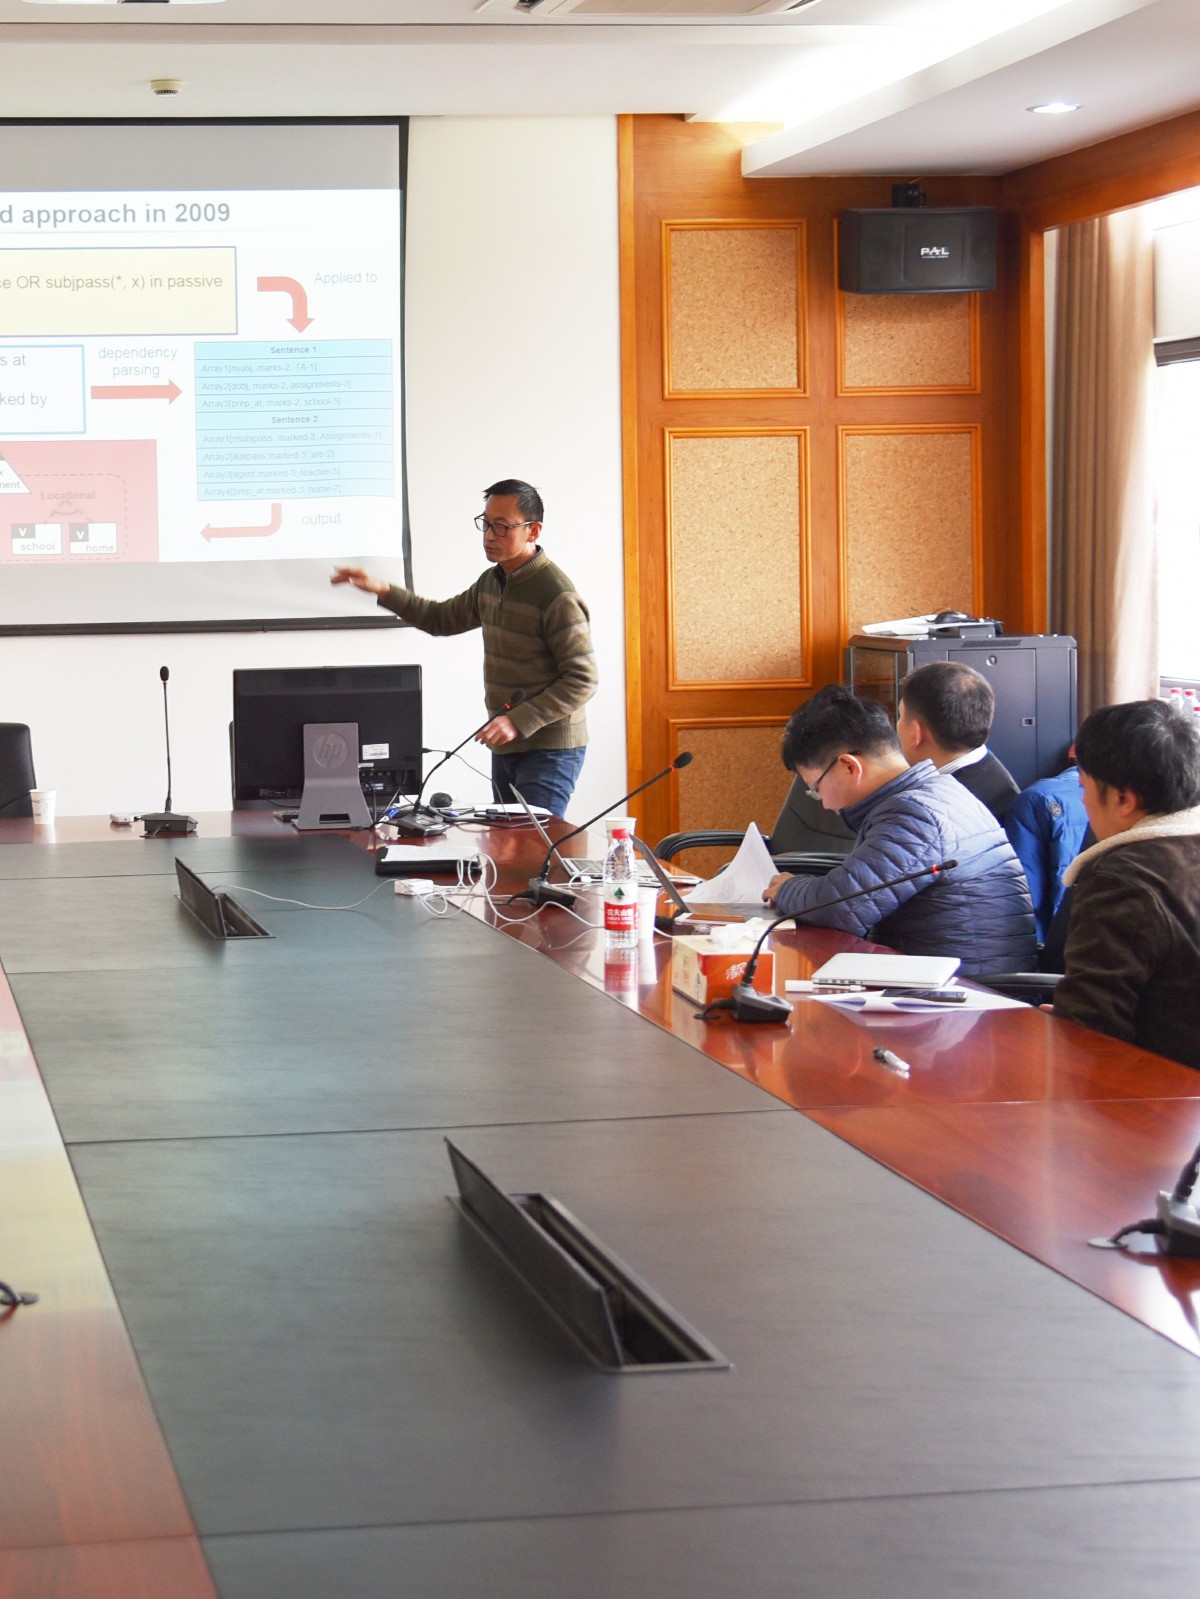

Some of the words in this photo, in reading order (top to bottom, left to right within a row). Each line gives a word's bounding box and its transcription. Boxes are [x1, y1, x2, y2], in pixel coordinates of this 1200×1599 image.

[22, 203, 136, 228] approach
[146, 203, 166, 223] in
[175, 202, 230, 223] 2009
[920, 246, 950, 256] PAL
[16, 275, 41, 289] OR
[150, 274, 162, 288] in
[167, 274, 223, 290] passive
[314, 271, 362, 287] Applied
[366, 271, 378, 283] to
[98, 347, 178, 361] dependency
[270, 345, 310, 354] Sentence
[12, 353, 27, 367] at
[112, 365, 161, 379] parsing
[30, 392, 47, 408] by
[271, 415, 310, 424] Sentence
[313, 415, 320, 423] 2
[40, 490, 97, 500] Locational
[301, 511, 342, 527] output
[20, 542, 55, 551] school
[86, 544, 115, 552] home
[319, 735, 346, 767] hp
